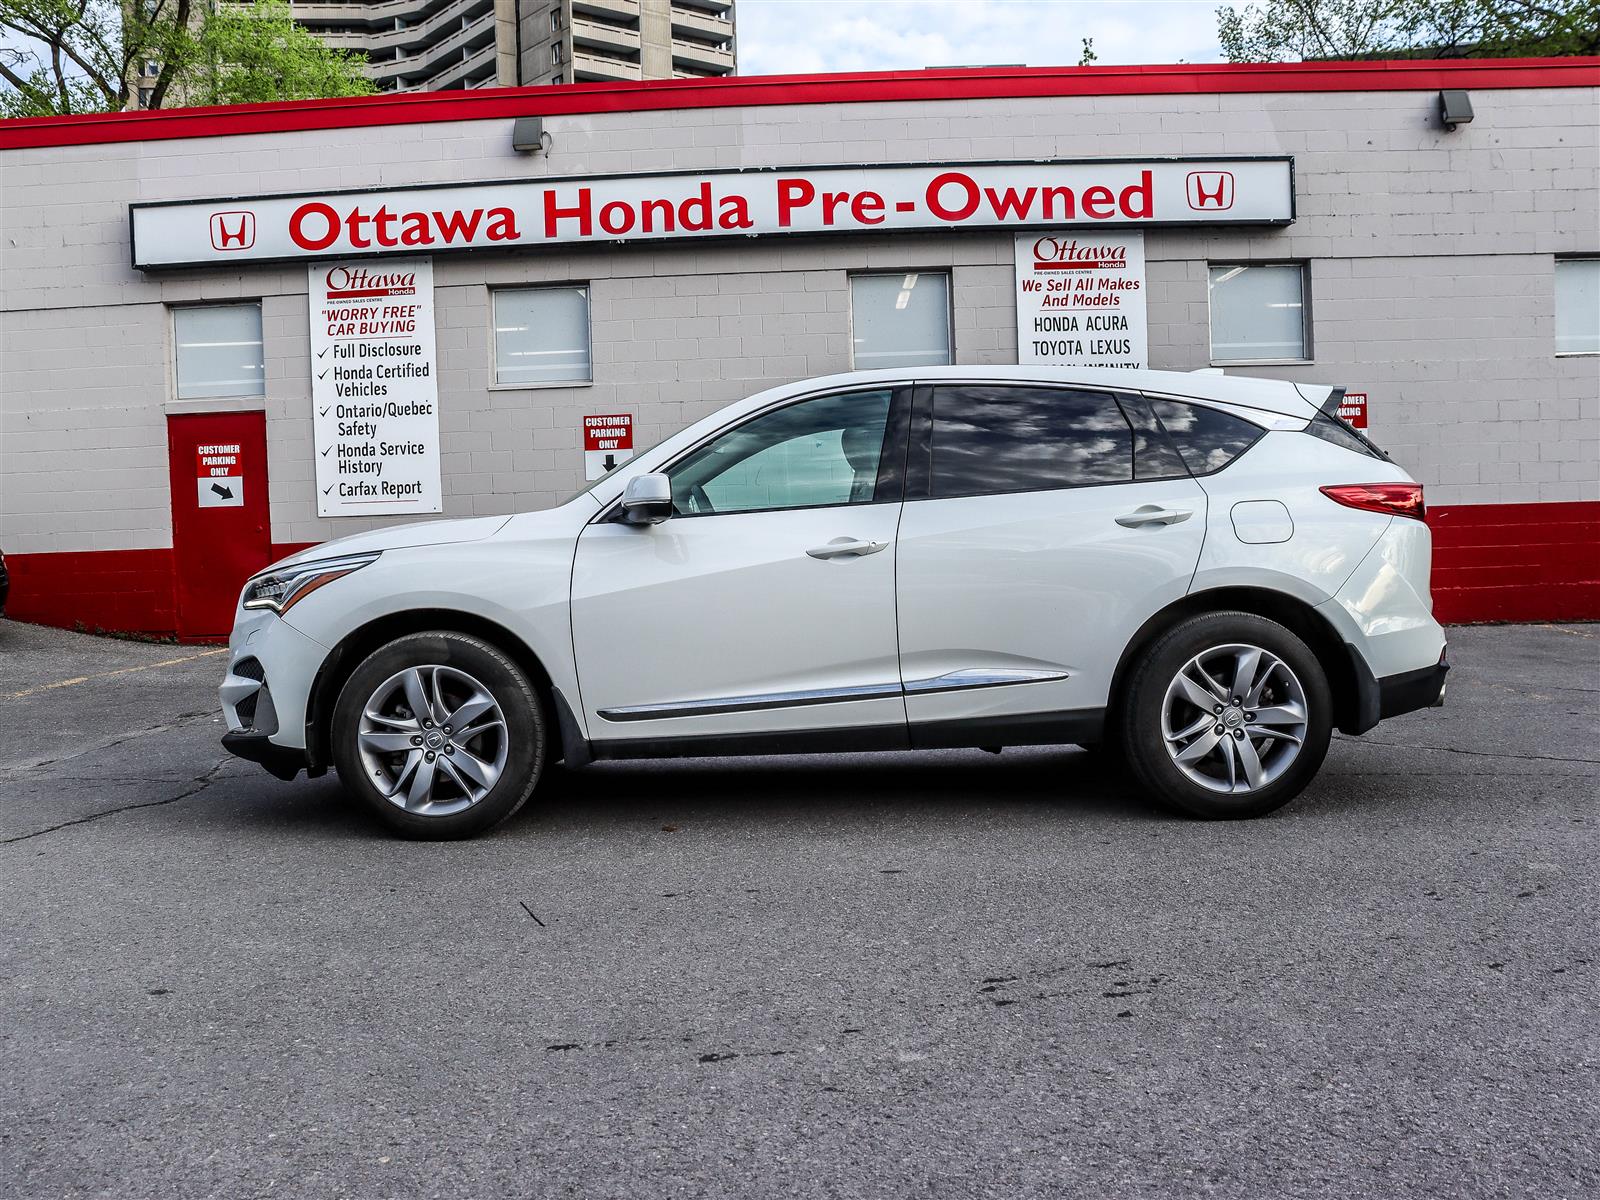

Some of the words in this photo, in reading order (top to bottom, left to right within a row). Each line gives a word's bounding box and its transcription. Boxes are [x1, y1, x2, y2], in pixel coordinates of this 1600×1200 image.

[288, 201, 521, 252] Ottawa
[543, 181, 753, 239] Honda
[776, 169, 1154, 226] Pre-Owned
[1033, 236, 1127, 261] Ottawa
[1098, 261, 1125, 269] Honda
[326, 266, 415, 290] Ottawa
[1022, 279, 1043, 292] We
[1046, 278, 1072, 292] Sell
[1074, 277, 1094, 291] All
[1097, 276, 1140, 291] Makes
[388, 288, 415, 296] Honda
[1041, 293, 1069, 307] And
[1072, 292, 1121, 306] Models
[322, 306, 379, 322] "WORRY
[382, 304, 422, 319] FREE"
[327, 323, 355, 337] CAR
[359, 319, 416, 335] BUYING
[1034, 316, 1079, 332] HONDA
[1086, 315, 1128, 331] ACURA
[333, 343, 355, 359] Full
[359, 341, 422, 358] Disclosure
[1032, 340, 1084, 356] TOYOTA
[1090, 339, 1131, 355] LEXUS
[333, 364, 373, 381] Honda
[376, 361, 430, 379] Certified
[335, 381, 388, 397] Vehicles
[1342, 395, 1365, 405] OMER
[336, 400, 433, 419] Ontario/Quebec
[1336, 407, 1361, 417] RKING
[338, 420, 377, 439] Safety
[585, 416, 630, 426] CUSTOMER
[590, 428, 626, 438] PARKING
[198, 445, 240, 454] CUSTOMER
[337, 441, 376, 458] Honda
[379, 440, 425, 456] Service
[598, 439, 619, 449] ONLY
[202, 456, 236, 465] PARKING
[338, 459, 383, 477] History
[210, 467, 229, 476] ONLY
[339, 480, 378, 497] Carfax
[381, 480, 423, 499] Report
